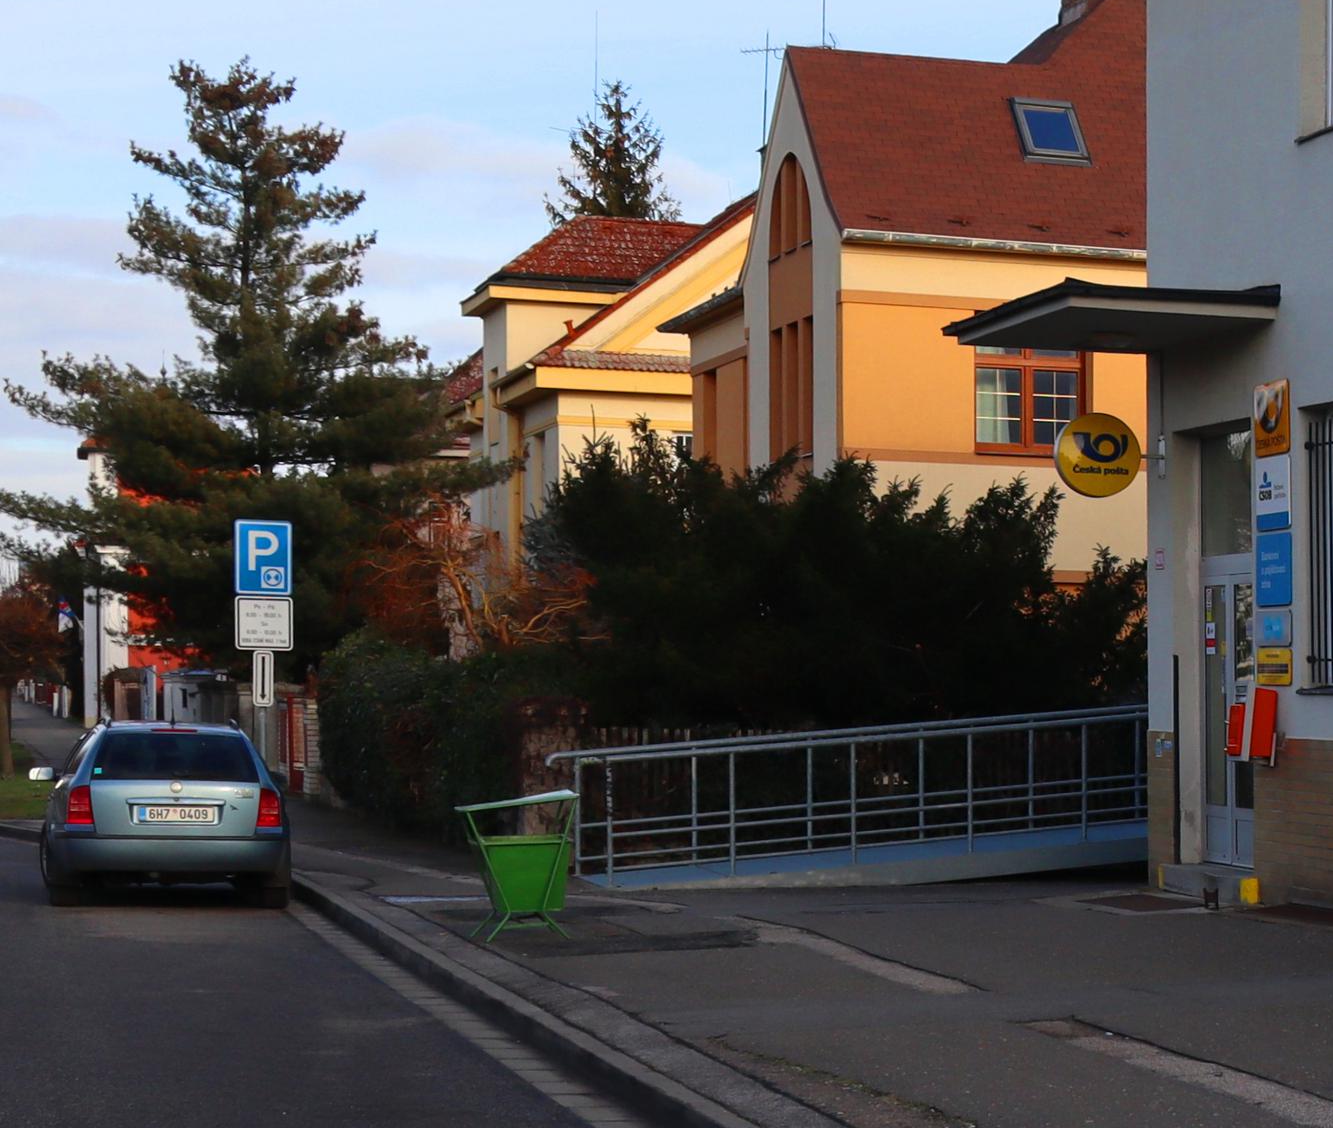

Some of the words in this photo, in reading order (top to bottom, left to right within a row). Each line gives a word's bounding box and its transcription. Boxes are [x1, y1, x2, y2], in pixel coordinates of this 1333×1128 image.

[248, 530, 280, 571] P
[148, 808, 170, 820] 6H7
[179, 809, 209, 820] 0409
